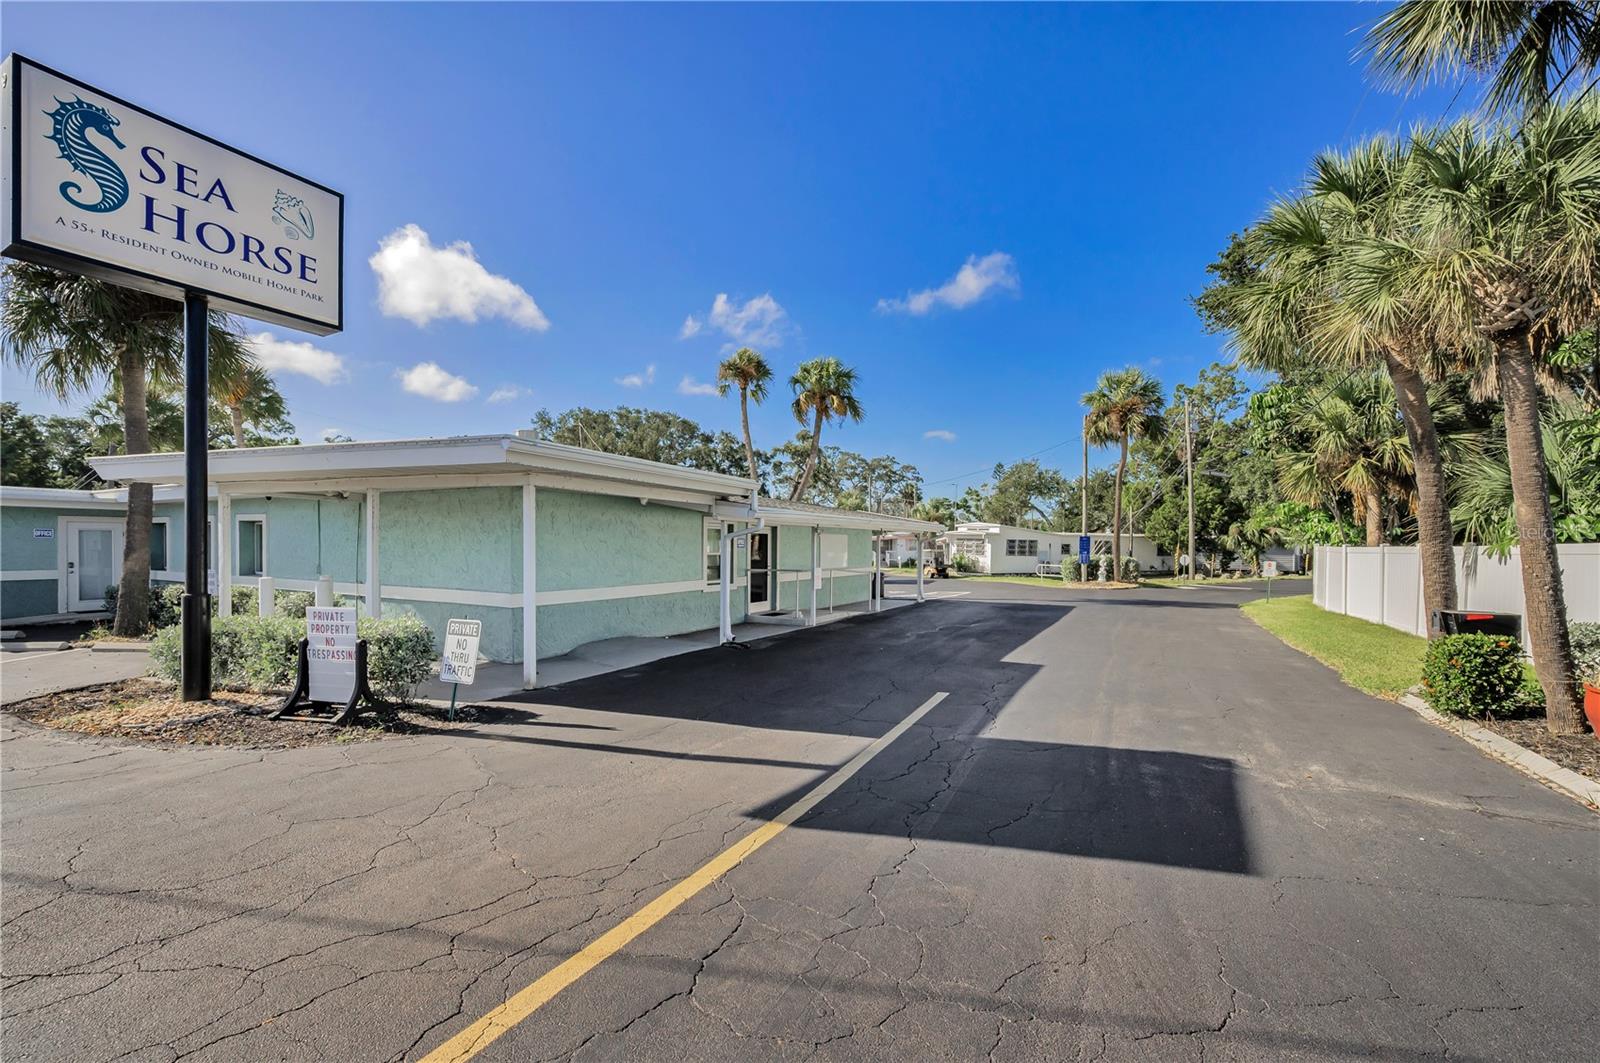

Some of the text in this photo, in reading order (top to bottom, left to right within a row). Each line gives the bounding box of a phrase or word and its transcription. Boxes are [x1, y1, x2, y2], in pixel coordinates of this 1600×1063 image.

[140, 146, 239, 213] SEA
[140, 193, 318, 284] HORSE
[55, 216, 324, 303] A 55+ RESIDENT OWNED MOBILE HOME PARK
[313, 611, 345, 622] PRIVATE
[311, 623, 350, 635] PROPERTY
[450, 623, 478, 636] PRIVATE
[325, 637, 336, 647] NO
[456, 638, 468, 650] NO
[307, 649, 356, 660] TRESPASSIN
[451, 651, 470, 663] THRU
[444, 663, 473, 677] TRAFFIC
